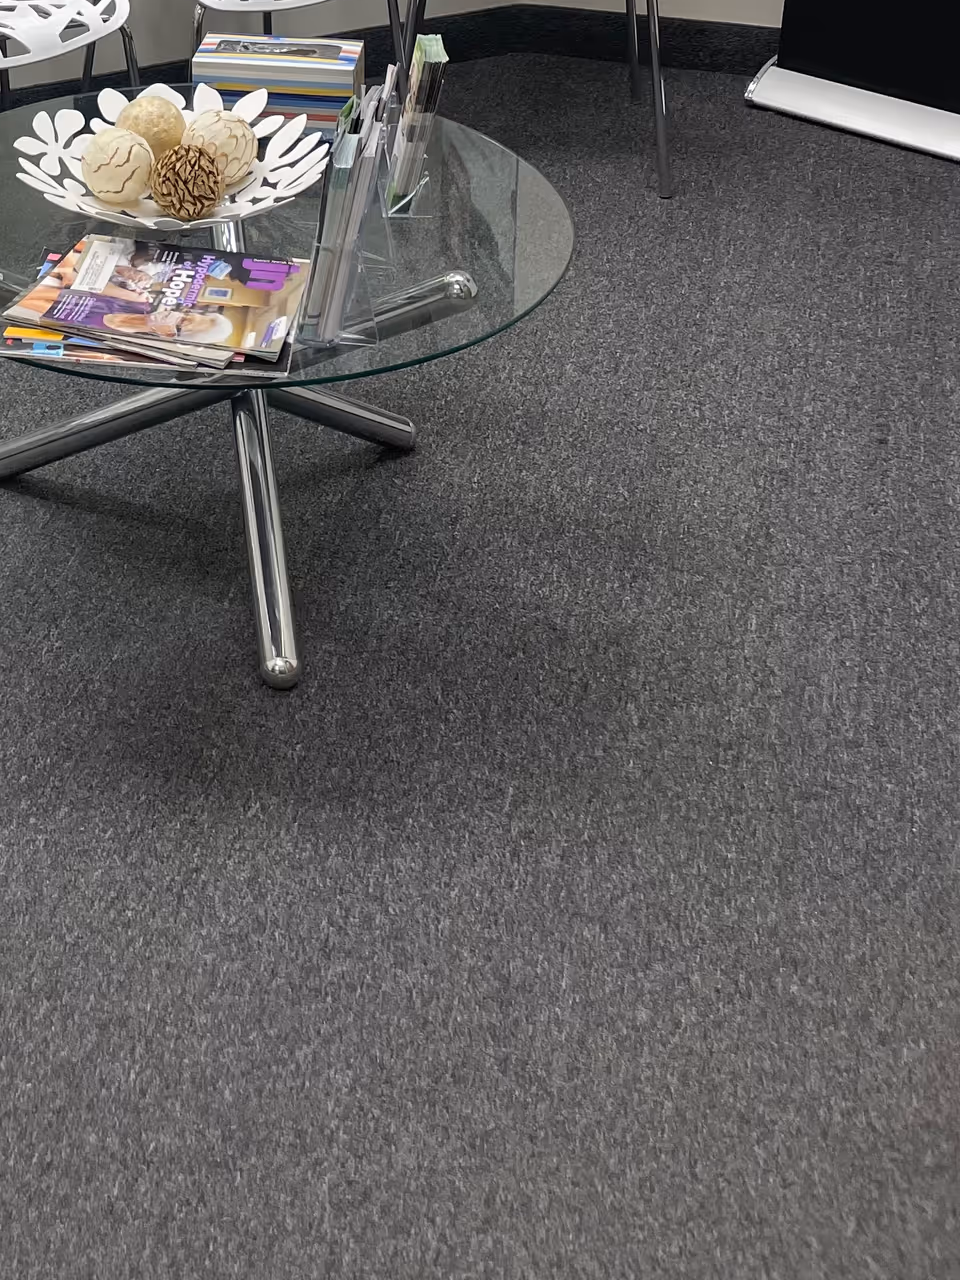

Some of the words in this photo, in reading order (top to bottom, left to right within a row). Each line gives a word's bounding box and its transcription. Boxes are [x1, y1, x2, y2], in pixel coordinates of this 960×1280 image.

[182, 260, 193, 270] of
[182, 254, 216, 308] Hypodermic
[161, 269, 196, 306] Hope
